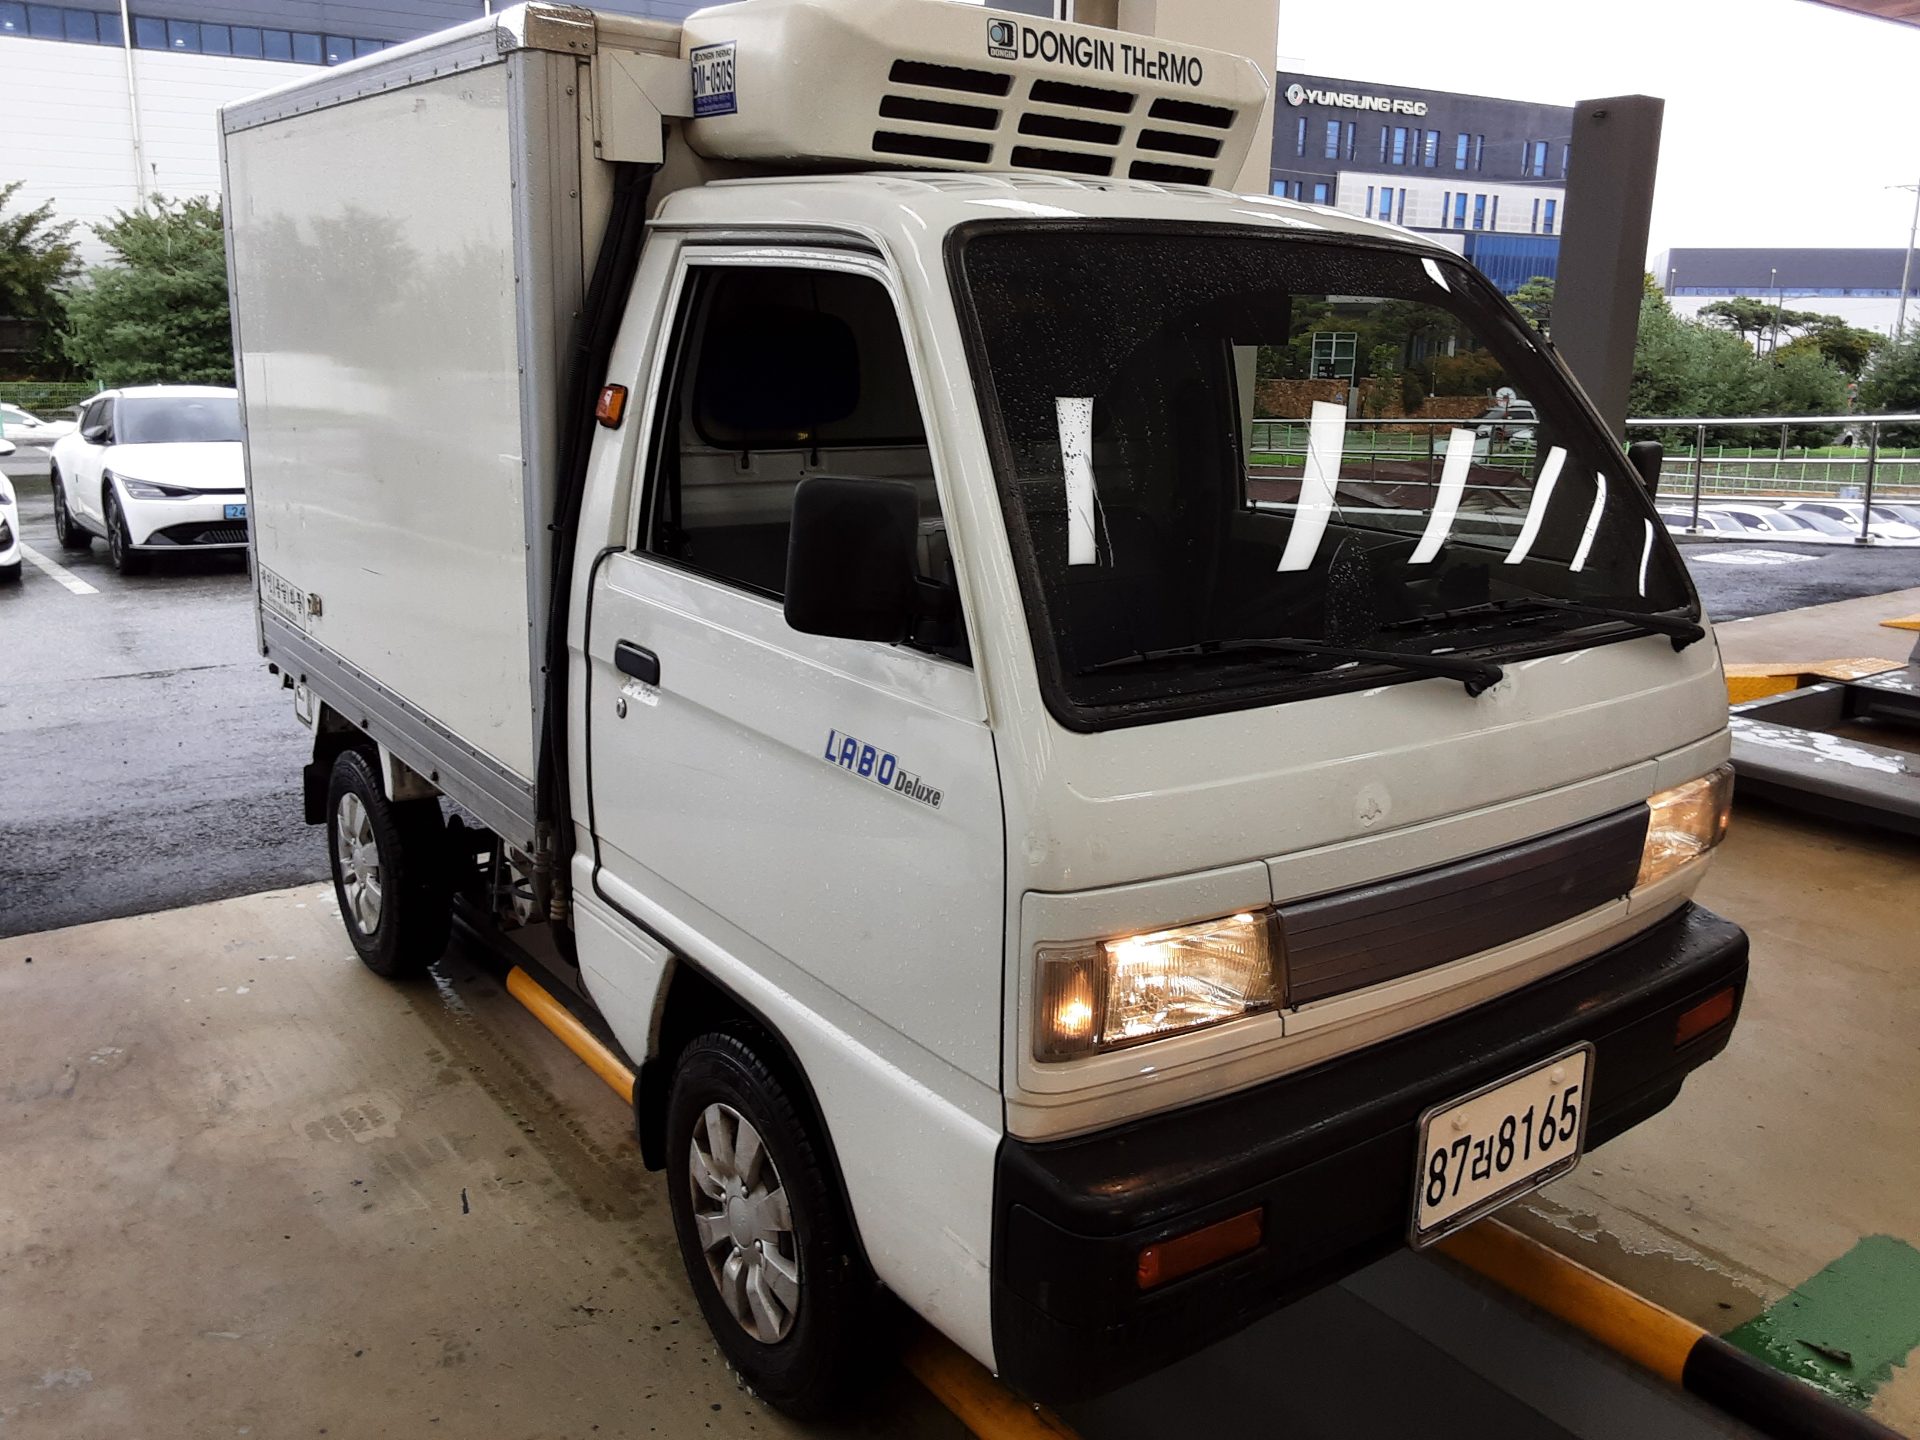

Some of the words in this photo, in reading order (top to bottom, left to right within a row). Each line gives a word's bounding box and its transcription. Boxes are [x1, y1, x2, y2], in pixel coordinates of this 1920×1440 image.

[990, 47, 1016, 59] DONGIN
[1023, 27, 1114, 72] DONGIN
[693, 59, 733, 96] DM-050S
[1305, 88, 1392, 112] YUNSUNG
[1392, 98, 1427, 116] F&C
[825, 729, 897, 786] LABO
[894, 770, 942, 806] Deluxe
[1426, 1084, 1579, 1208] 87러8165
